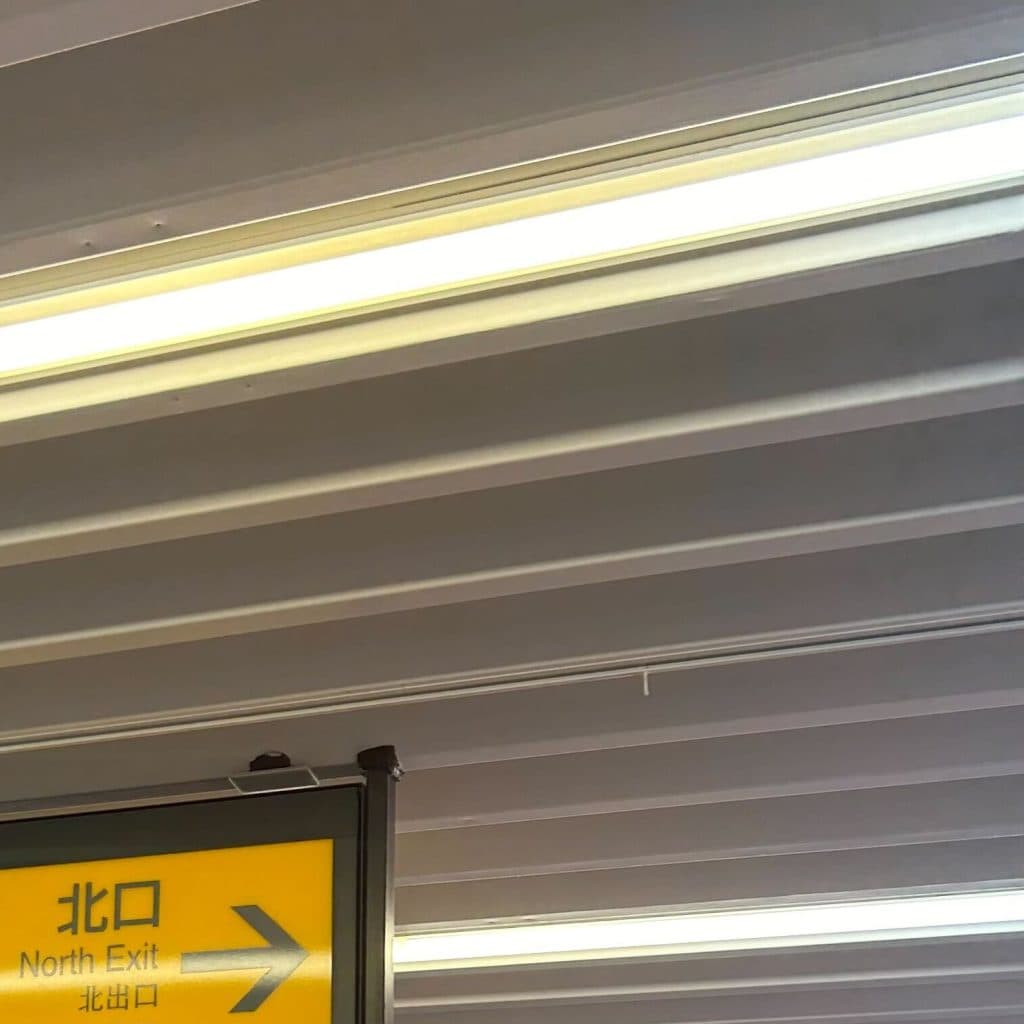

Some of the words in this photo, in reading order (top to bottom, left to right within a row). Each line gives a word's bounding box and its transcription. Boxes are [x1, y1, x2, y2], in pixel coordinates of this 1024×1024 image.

[56, 879, 161, 936] 北口
[19, 946, 94, 979] North
[105, 941, 159, 974] Exit
[78, 983, 158, 1013] 北出口
